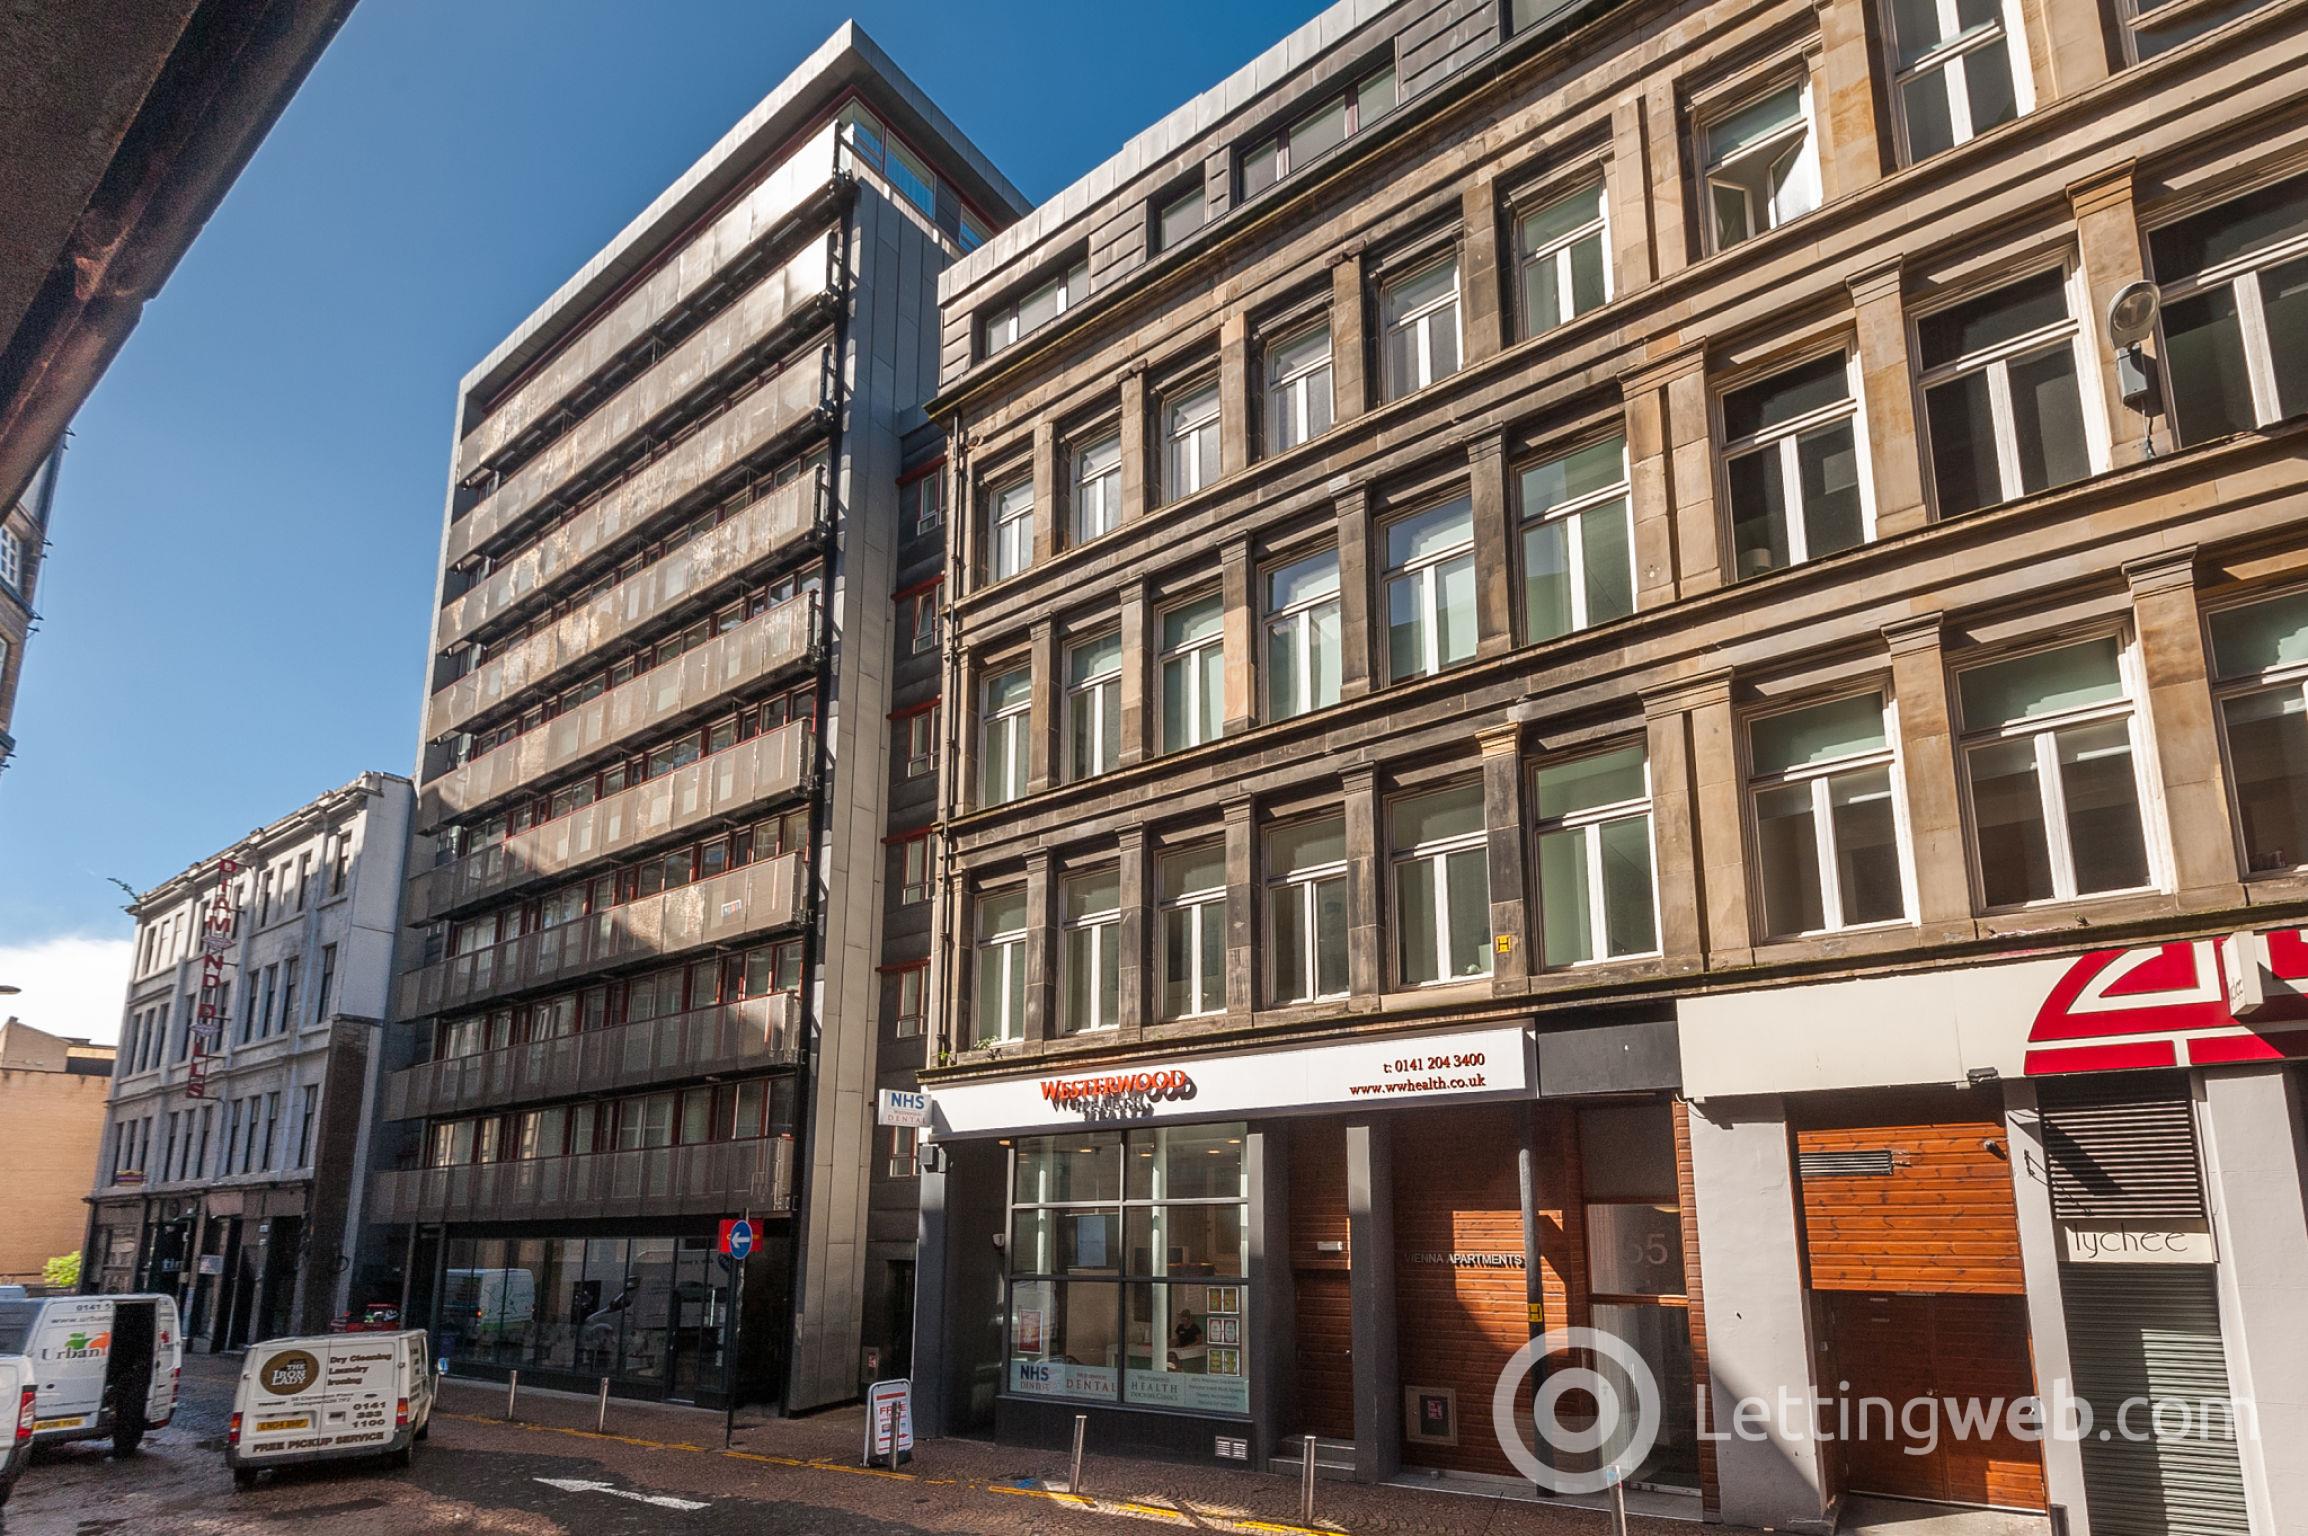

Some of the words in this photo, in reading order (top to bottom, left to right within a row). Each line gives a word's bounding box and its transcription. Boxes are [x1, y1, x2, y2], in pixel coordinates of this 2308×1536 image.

[1395, 1058, 1423, 1072] 0141
[1427, 1056, 1451, 1070] 204
[1453, 1053, 1485, 1067] 3400
[1040, 1069, 1187, 1101] WESTERWOOD
[1349, 1073, 1486, 1095] www.wwhealth.co.uk
[891, 1092, 925, 1109] NHS
[2074, 1222, 2189, 1258] lychee
[1446, 1253, 1523, 1265] APARTMENTS
[350, 1353, 392, 1362] Cleaning
[272, 1370, 307, 1379] IRON
[328, 1366, 369, 1375] Laundry
[1020, 1365, 1049, 1381] NHS
[271, 1376, 307, 1386] LADY
[1066, 1378, 1116, 1392] DENTAL
[1131, 1381, 1178, 1394] HEALTH
[353, 1402, 386, 1410] 0141
[352, 1419, 386, 1428] 1100
[253, 1442, 285, 1453] FREE
[287, 1437, 333, 1450] PICKUP
[335, 1431, 384, 1444] SERVICE
